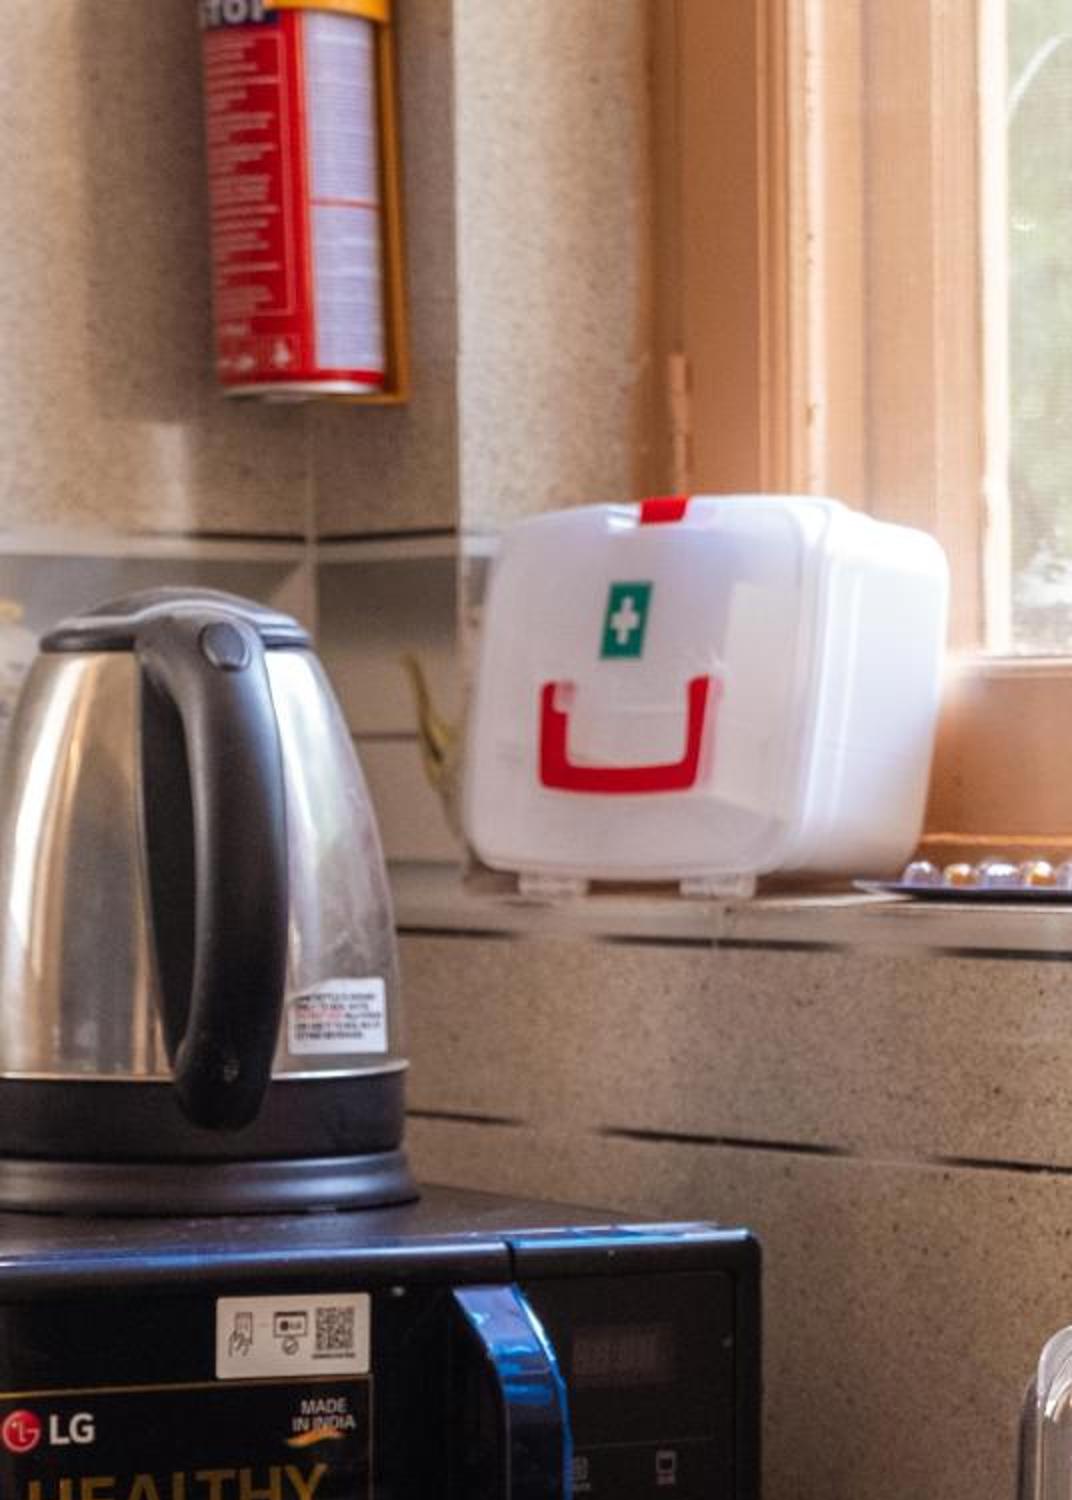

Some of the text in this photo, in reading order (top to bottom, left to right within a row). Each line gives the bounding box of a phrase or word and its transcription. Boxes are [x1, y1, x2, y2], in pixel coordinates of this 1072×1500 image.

[301, 1398, 347, 1415] MADE
[49, 1413, 95, 1445] LG
[291, 1416, 310, 1432] IN
